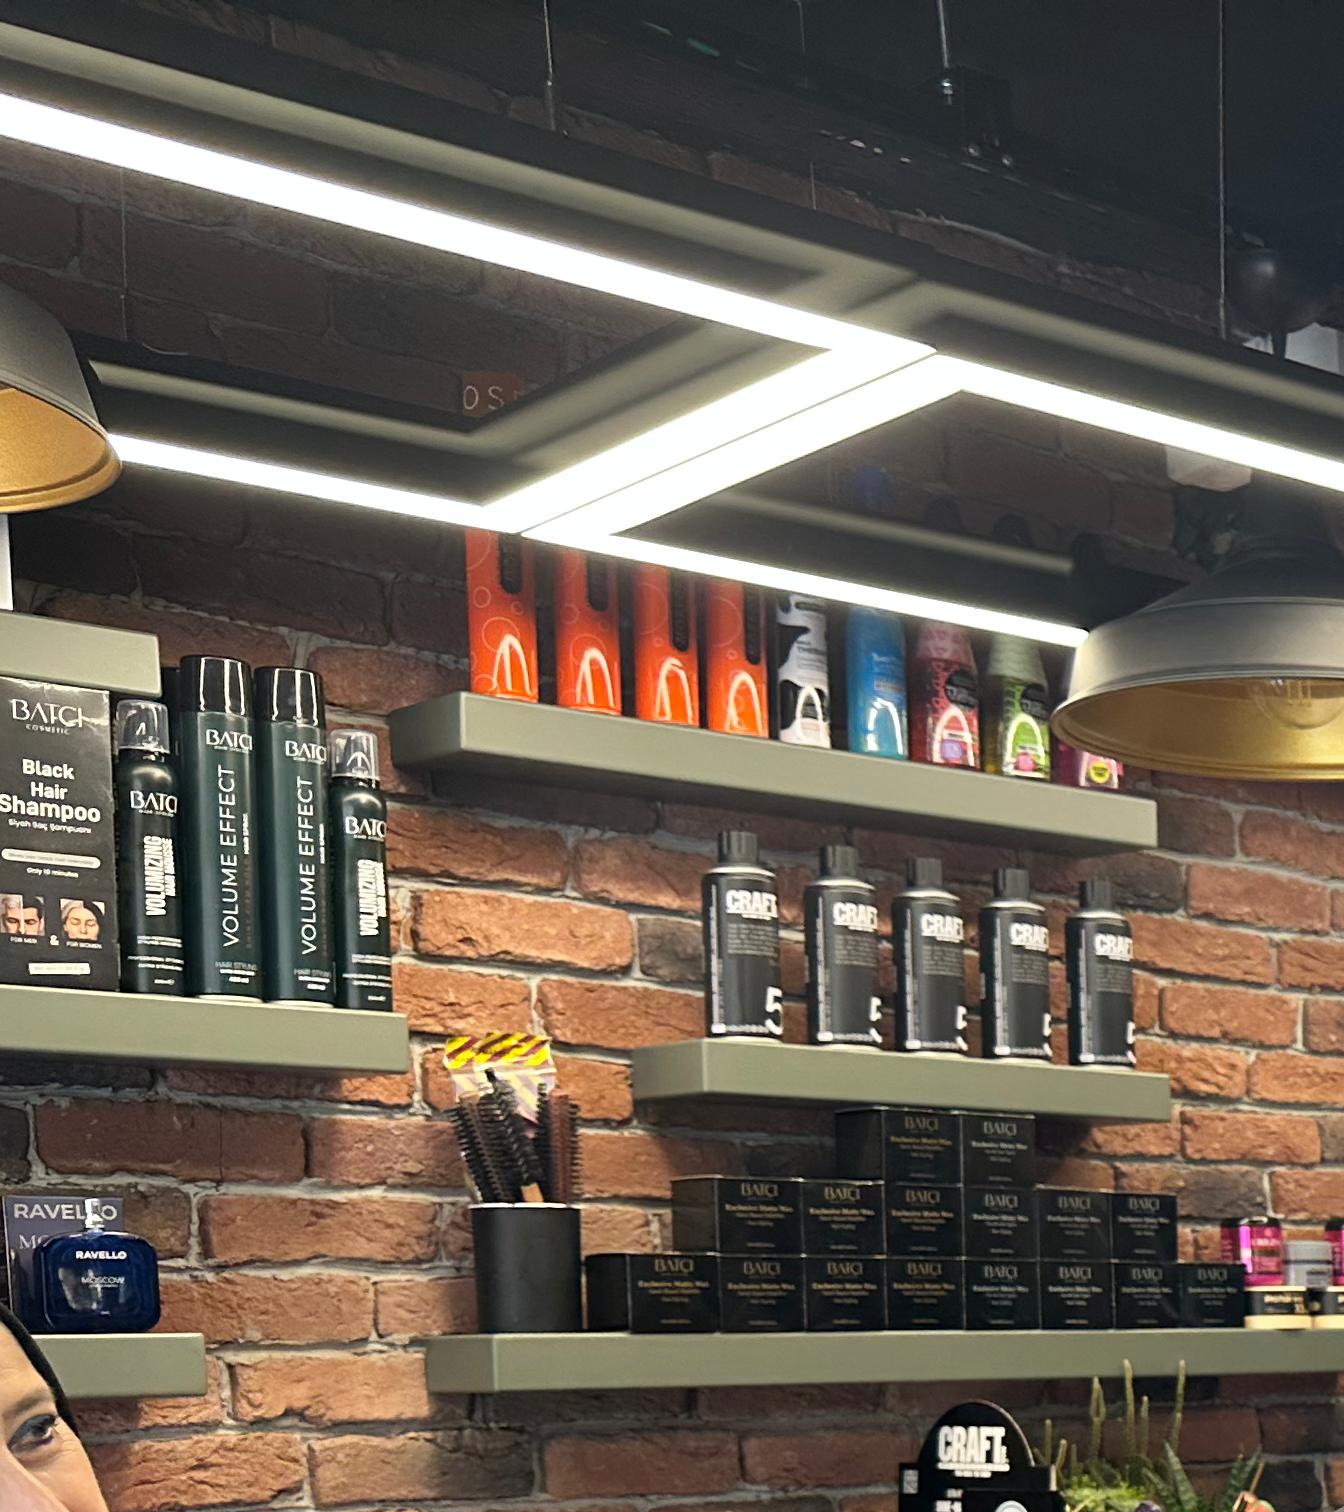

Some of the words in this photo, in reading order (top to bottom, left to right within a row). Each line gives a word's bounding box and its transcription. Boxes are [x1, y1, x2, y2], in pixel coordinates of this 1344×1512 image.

[22, 759, 75, 780] Black
[30, 782, 68, 801] Hair
[218, 764, 237, 846] EFFECT
[0, 794, 101, 823] Shampoo
[296, 776, 315, 856] EFFECT
[143, 836, 166, 915] VOLUMIZING
[221, 854, 240, 947] VOLUME
[300, 863, 317, 955] VOLUME
[14, 1203, 118, 1221] RAVELO
[75, 1251, 128, 1260] RAVELLO
[81, 1276, 125, 1284] MOSCOW
[938, 1425, 1006, 1463] CRAFT
